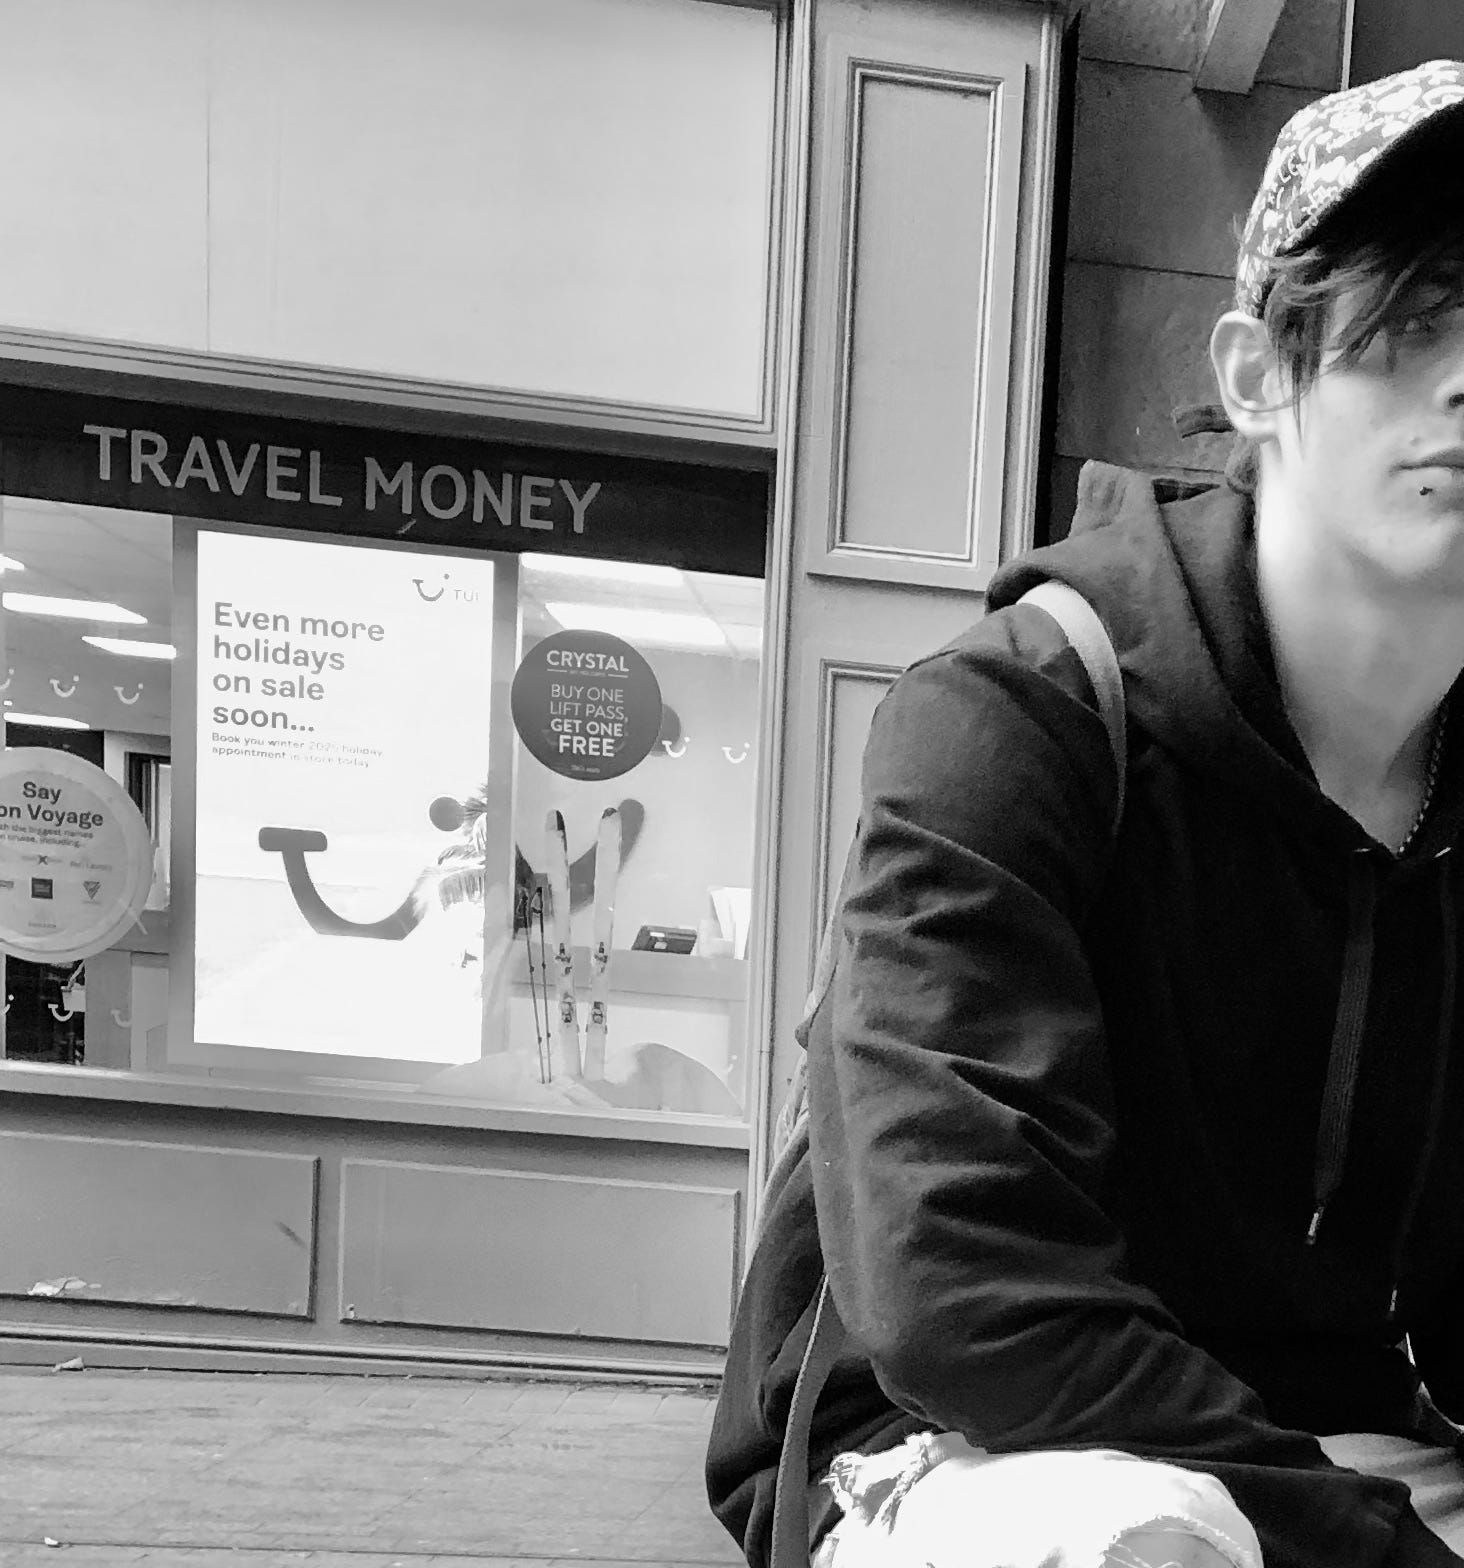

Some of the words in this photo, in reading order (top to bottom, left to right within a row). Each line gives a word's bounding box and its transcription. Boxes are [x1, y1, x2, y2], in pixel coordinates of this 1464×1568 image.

[82, 423, 343, 508] TRAVEL
[363, 456, 602, 535] MONEY
[453, 588, 480, 602] TUI
[213, 601, 291, 633] Even
[299, 615, 386, 642] more
[212, 634, 346, 675] holidays
[546, 649, 630, 673] CRYSTAL
[211, 672, 252, 694] on
[260, 674, 326, 701] sale
[551, 683, 585, 700] BUY
[586, 686, 625, 704] ONE
[211, 705, 316, 733] soon...
[549, 700, 582, 716] LIFT
[585, 703, 629, 724] PASS,
[550, 717, 583, 734] GET
[586, 720, 624, 738] ONE
[211, 732, 241, 744] Book
[267, 739, 306, 750] winter
[211, 745, 287, 761] appointment
[558, 733, 616, 758] FREE
[22, 780, 63, 805] Say
[0, 803, 22, 819] on
[27, 803, 104, 830] Voyage
